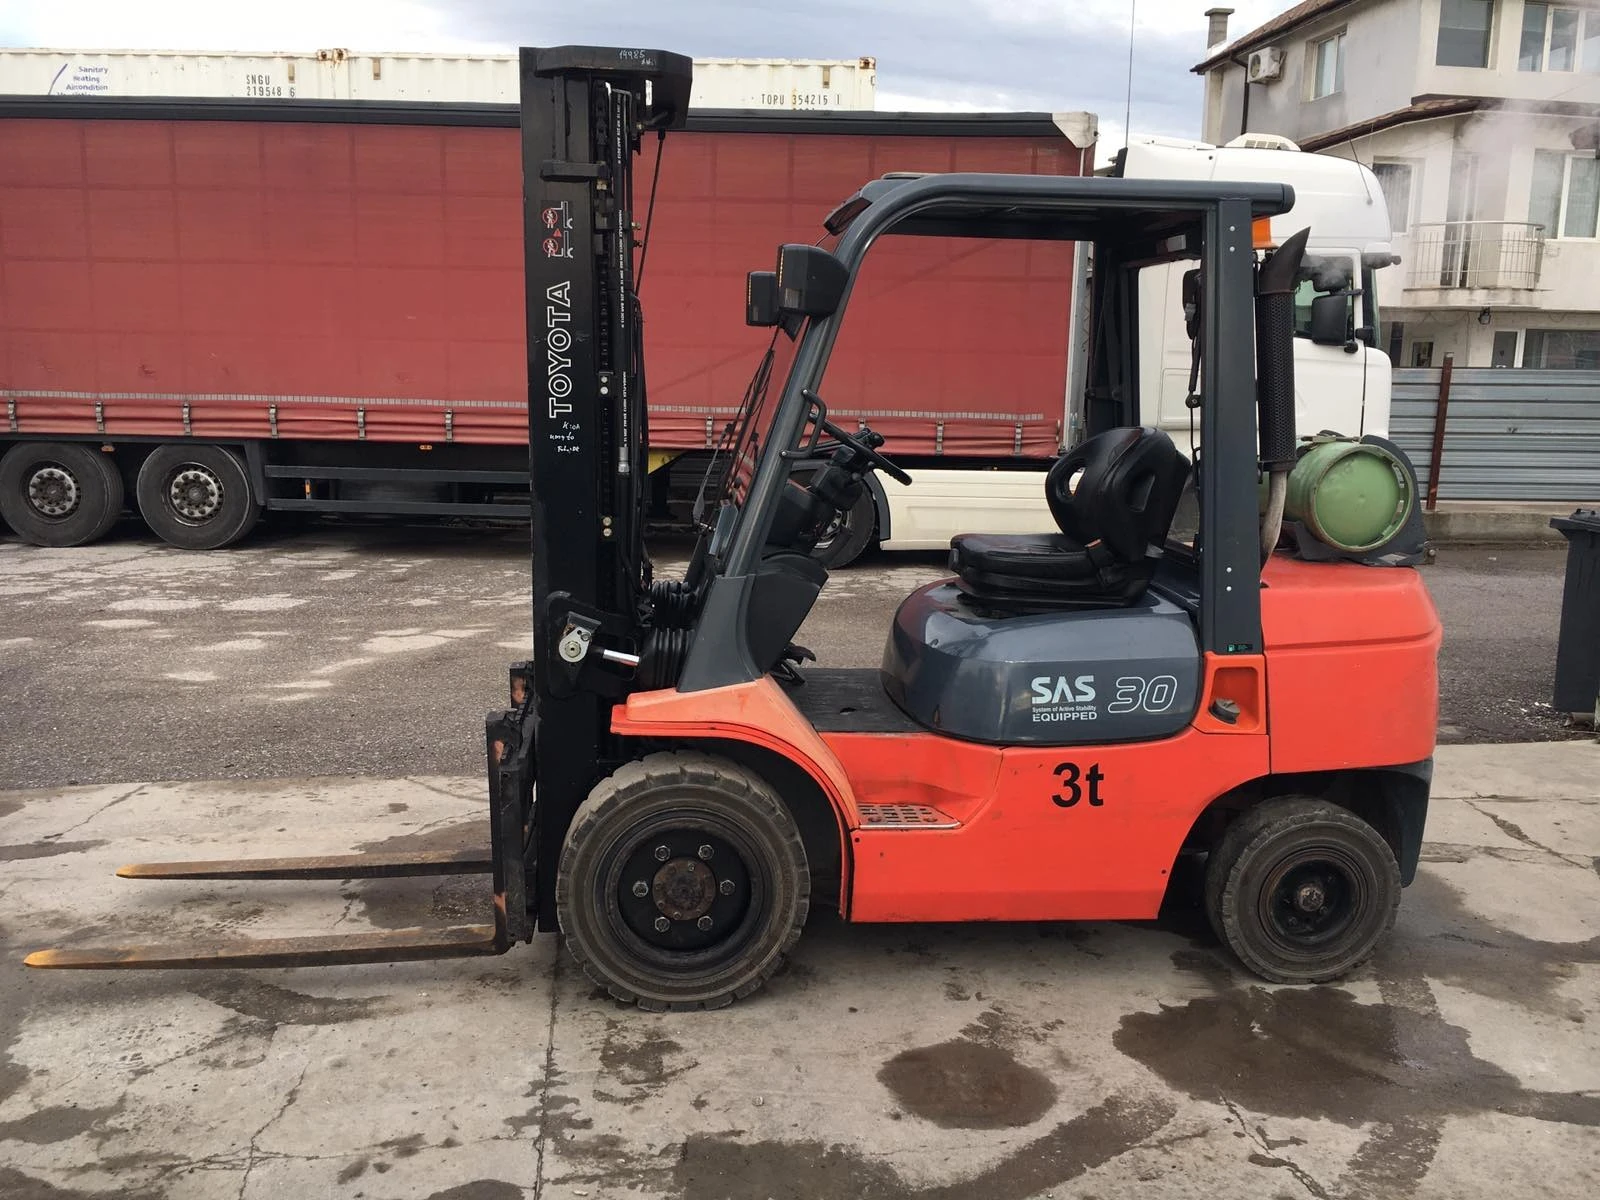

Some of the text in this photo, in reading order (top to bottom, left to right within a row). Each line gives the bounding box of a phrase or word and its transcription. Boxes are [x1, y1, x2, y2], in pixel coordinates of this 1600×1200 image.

[78, 66, 108, 74] Sanitary
[73, 75, 100, 83] Heating
[246, 74, 270, 85] SNGU
[246, 86, 295, 97] 219548 6
[761, 94, 785, 105] TOPU
[792, 94, 828, 105] 354215
[546, 281, 573, 418] TOYOTA
[1031, 675, 1097, 704] SAS
[1107, 675, 1178, 714] 30
[1032, 711, 1098, 722] EQUIPPED
[1052, 762, 1104, 807] 3t
